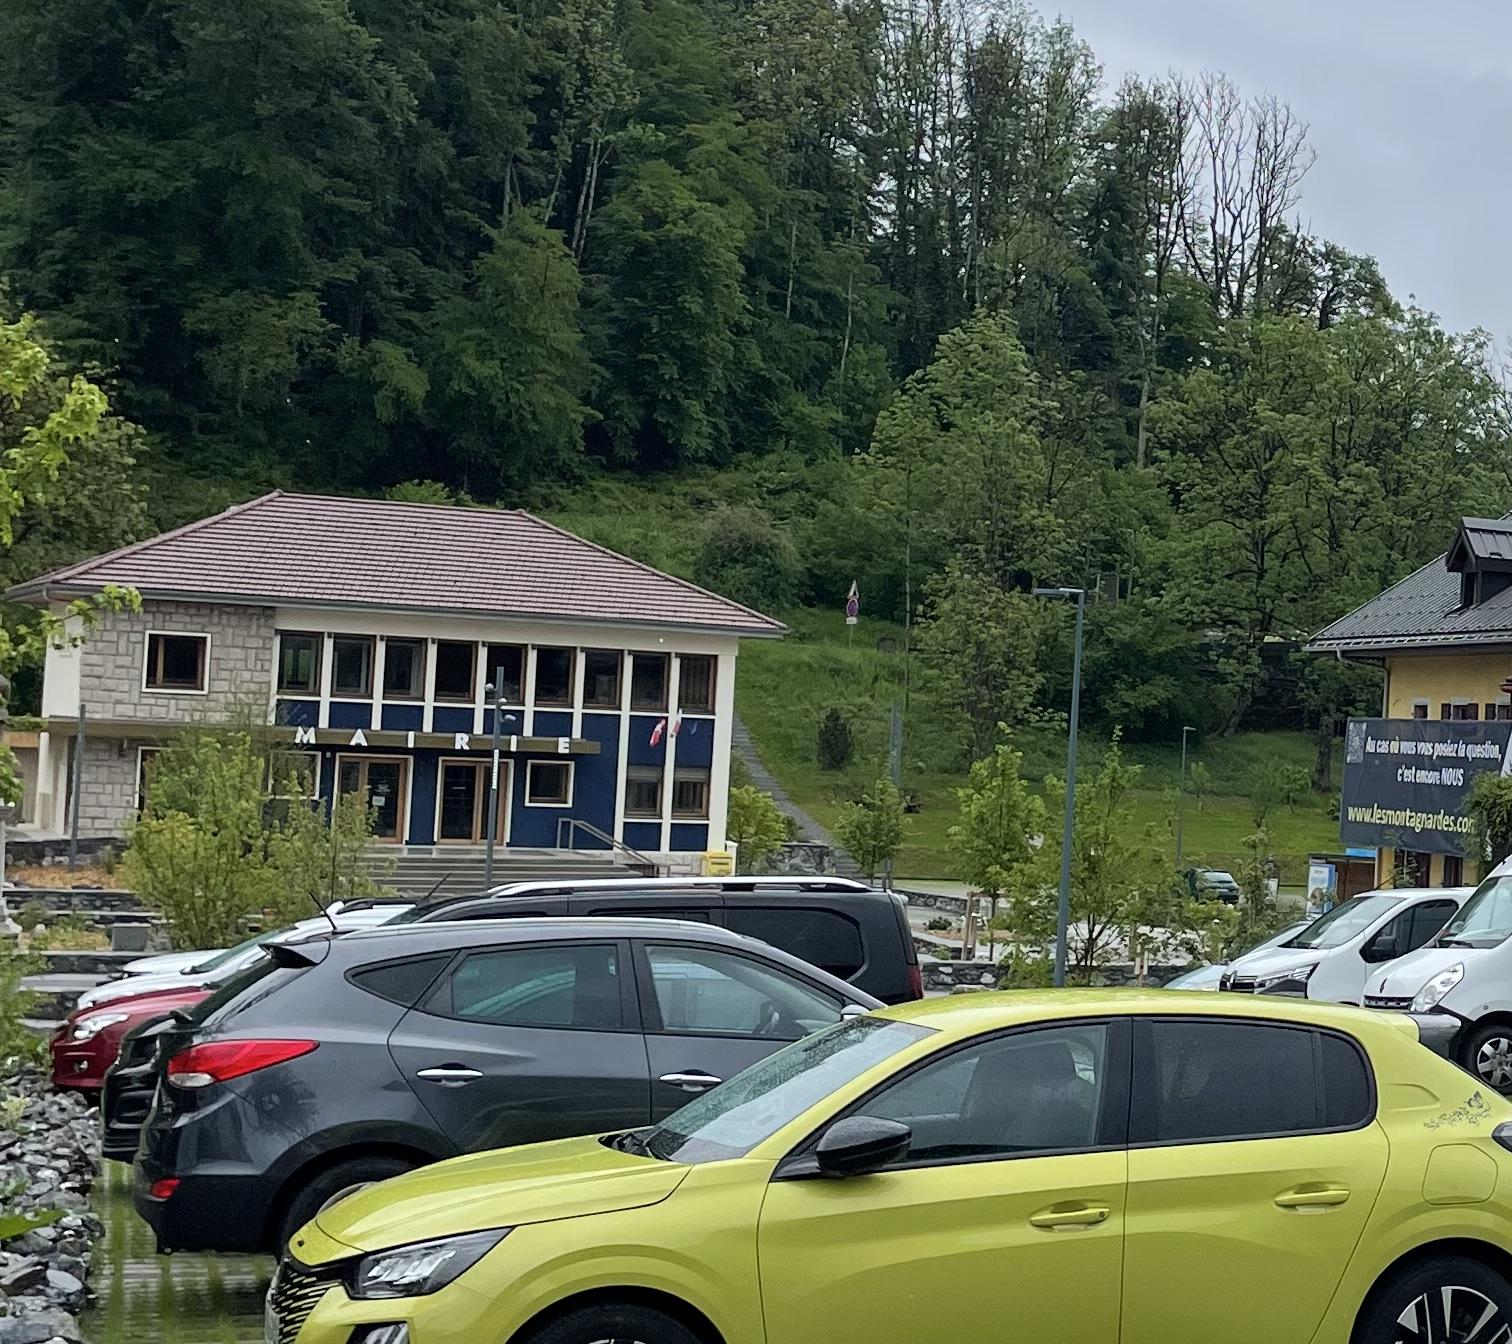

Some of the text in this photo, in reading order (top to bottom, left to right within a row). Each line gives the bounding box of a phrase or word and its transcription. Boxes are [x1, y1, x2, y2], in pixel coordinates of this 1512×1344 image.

[294, 726, 571, 754] MAIRIE
[1365, 736, 1376, 753] Au
[1376, 739, 1390, 754] cas
[1417, 741, 1434, 756] vous
[1458, 740, 1466, 757] la
[1466, 740, 1502, 763] question,
[1397, 764, 1464, 787] c'est encore NOUS
